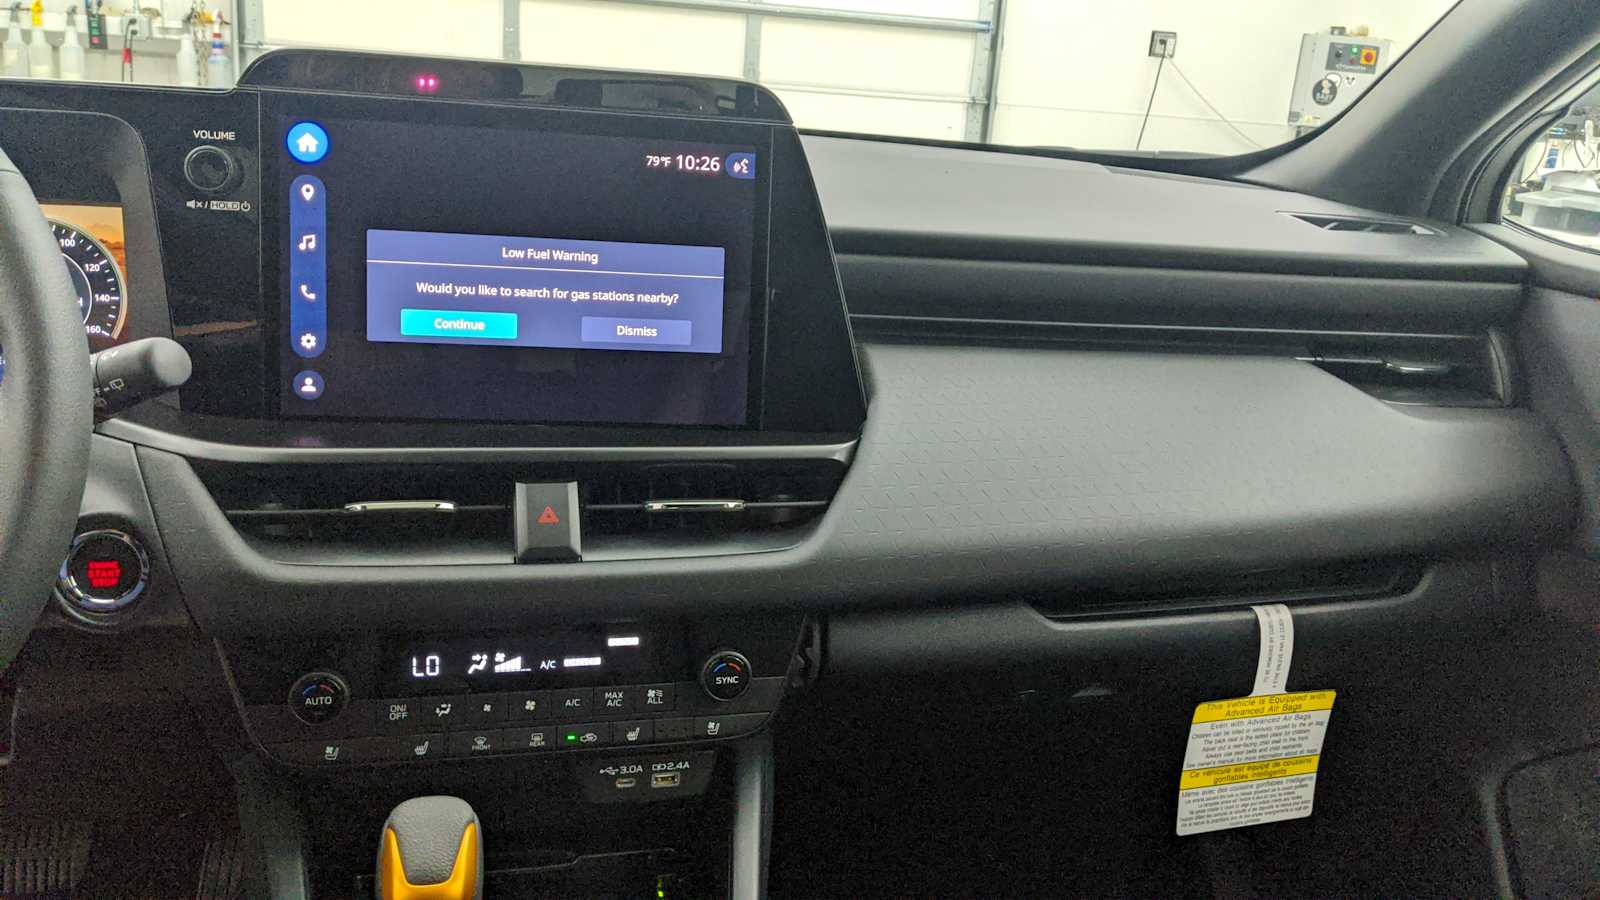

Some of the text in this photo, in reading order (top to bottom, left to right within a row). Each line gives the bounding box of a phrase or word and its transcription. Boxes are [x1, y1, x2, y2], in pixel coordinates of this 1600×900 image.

[192, 129, 236, 141] VOLUME
[676, 154, 721, 172] 10:26
[211, 201, 240, 210] HOLD
[60, 239, 76, 248] 100
[502, 247, 599, 265] Low Fuel Warning
[85, 263, 100, 273] 120
[95, 294, 111, 303] 140
[416, 281, 680, 306] Would you like to search for gas stations nearby?
[433, 317, 487, 332] Continue
[86, 325, 101, 335] 160
[616, 323, 658, 338] Dismiss
[540, 659, 557, 670] A/C
[715, 675, 739, 685] SYNC
[304, 696, 333, 706] AUTO
[604, 692, 624, 700] MAX
[647, 697, 663, 705] ALL
[565, 698, 581, 708] A/C
[606, 698, 622, 708] A/C
[1225, 702, 1303, 717] Advanced Air Bags
[389, 711, 408, 721] OFF
[620, 765, 643, 774] 3.0A
[666, 761, 690, 771] 2.4A
